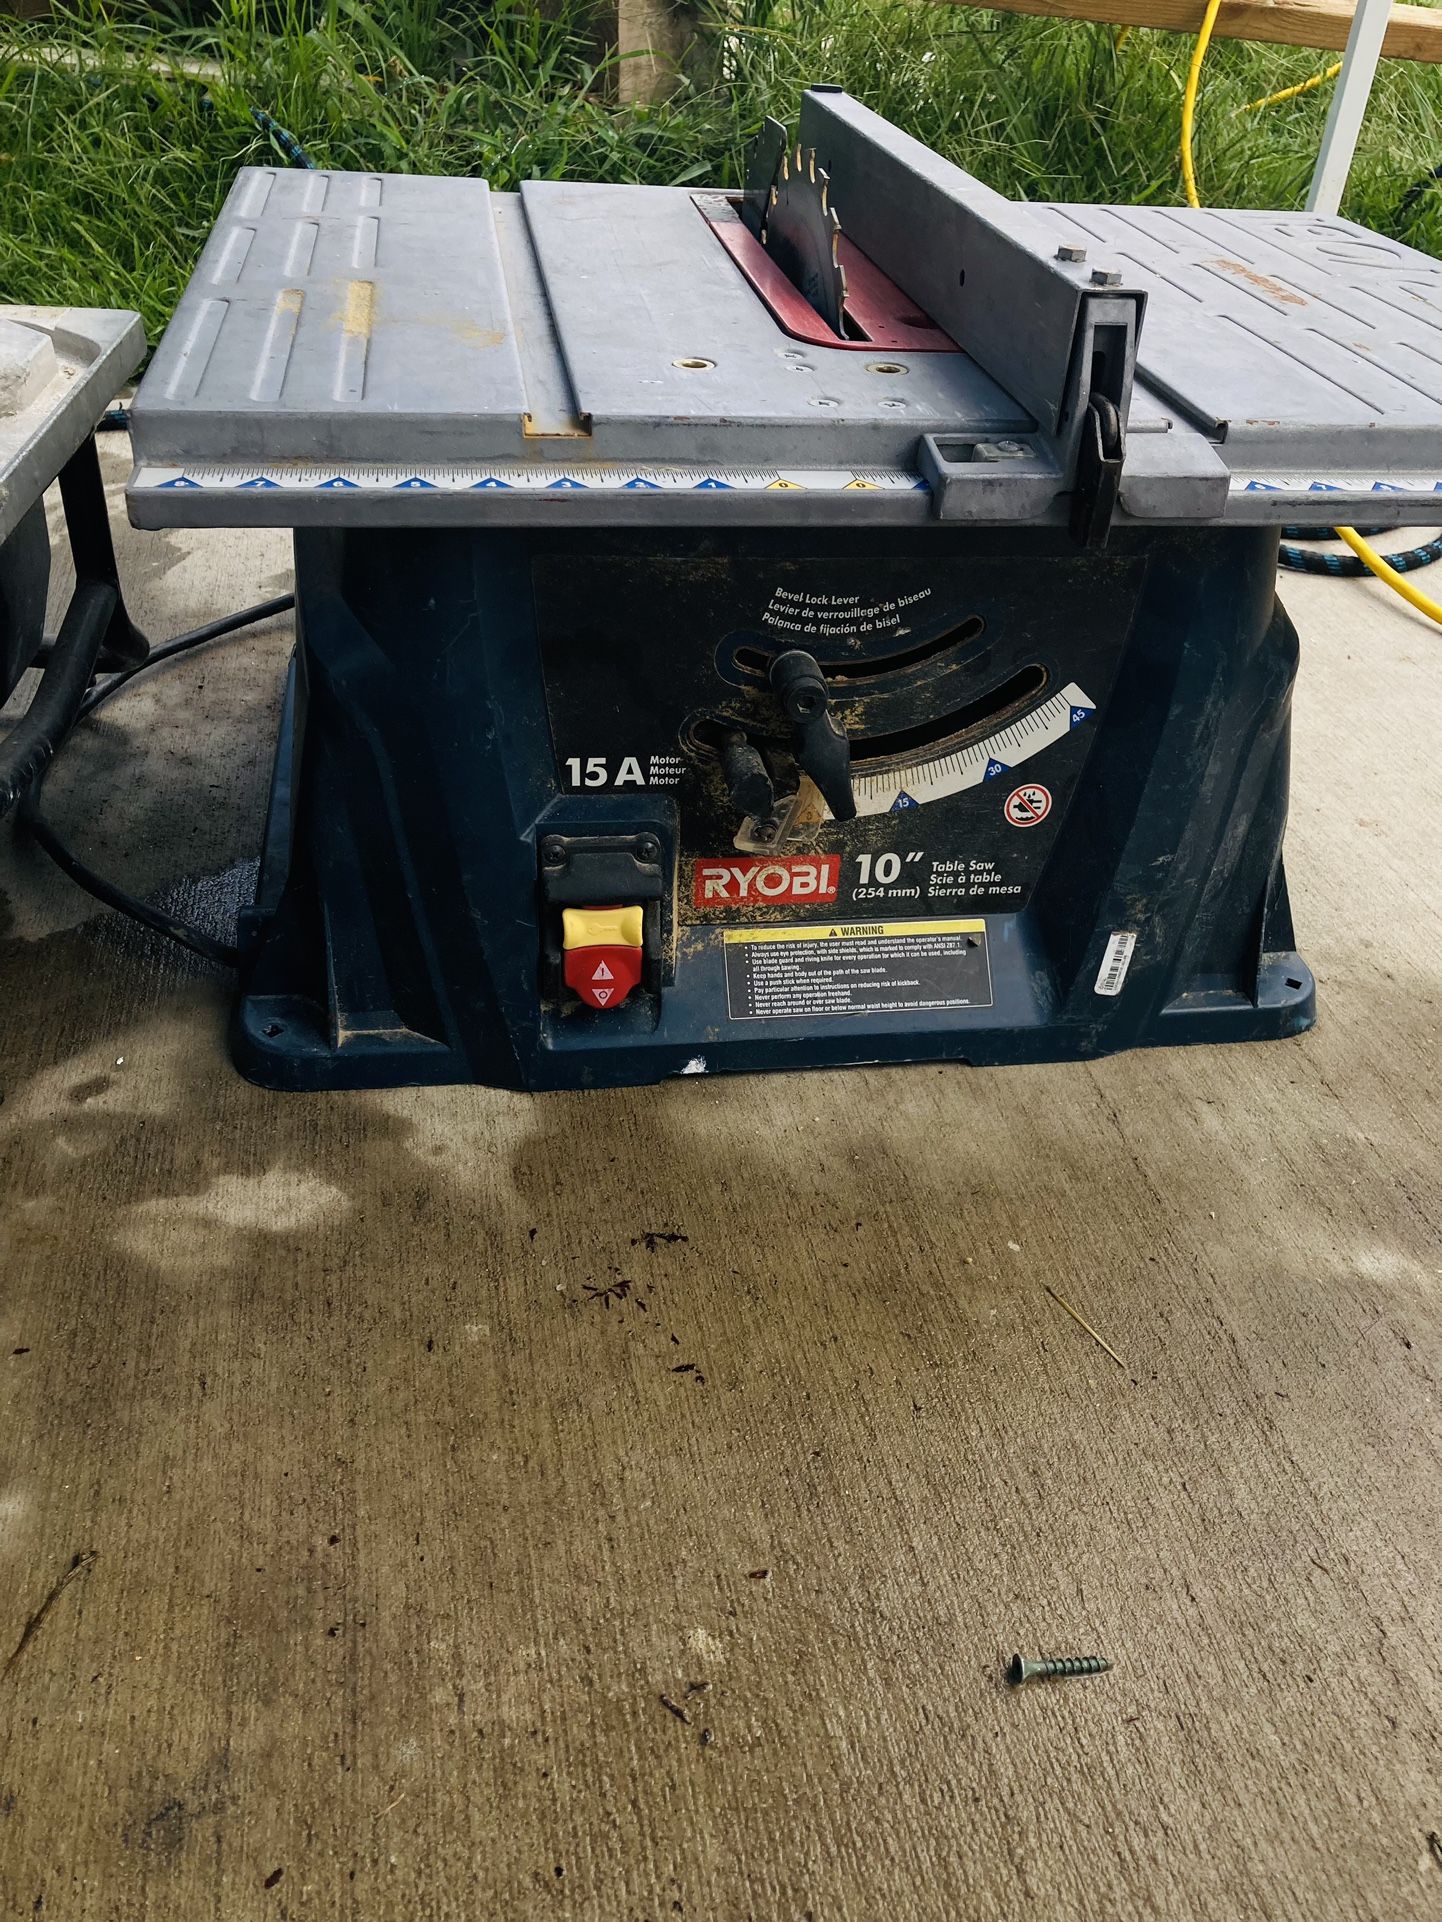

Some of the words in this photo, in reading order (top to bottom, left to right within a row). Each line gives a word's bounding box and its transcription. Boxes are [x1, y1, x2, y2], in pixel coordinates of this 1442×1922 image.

[774, 587, 803, 602] Bevel
[806, 593, 828, 605] Lock
[832, 596, 860, 605] Lever
[768, 600, 800, 615] Levier
[802, 607, 814, 618] de
[817, 606, 880, 619] verrouillage
[883, 602, 896, 612] de
[899, 587, 931, 608] biseau
[762, 612, 801, 631] Palanca
[804, 623, 817, 633] de
[820, 623, 857, 636] fijación
[860, 622, 872, 631] de
[876, 614, 900, 629] bisel
[649, 756, 680, 765] Motor
[898, 798, 910, 808] 15
[988, 764, 1002, 776] 30
[1072, 709, 1086, 723] 45
[565, 758, 608, 787] 15
[614, 757, 646, 785] A
[649, 766, 686, 775] Moteur
[649, 777, 680, 785] Motor
[932, 862, 965, 872] Table
[969, 860, 995, 870] Saw
[929, 874, 953, 884] Scie
[958, 872, 966, 883] à
[970, 872, 1001, 882] table
[852, 888, 885, 900] (254
[888, 886, 920, 898] mm)
[927, 886, 965, 897] Sierra
[969, 885, 984, 895] de
[988, 886, 1021, 894] mesa
[841, 926, 884, 936] WARNING
